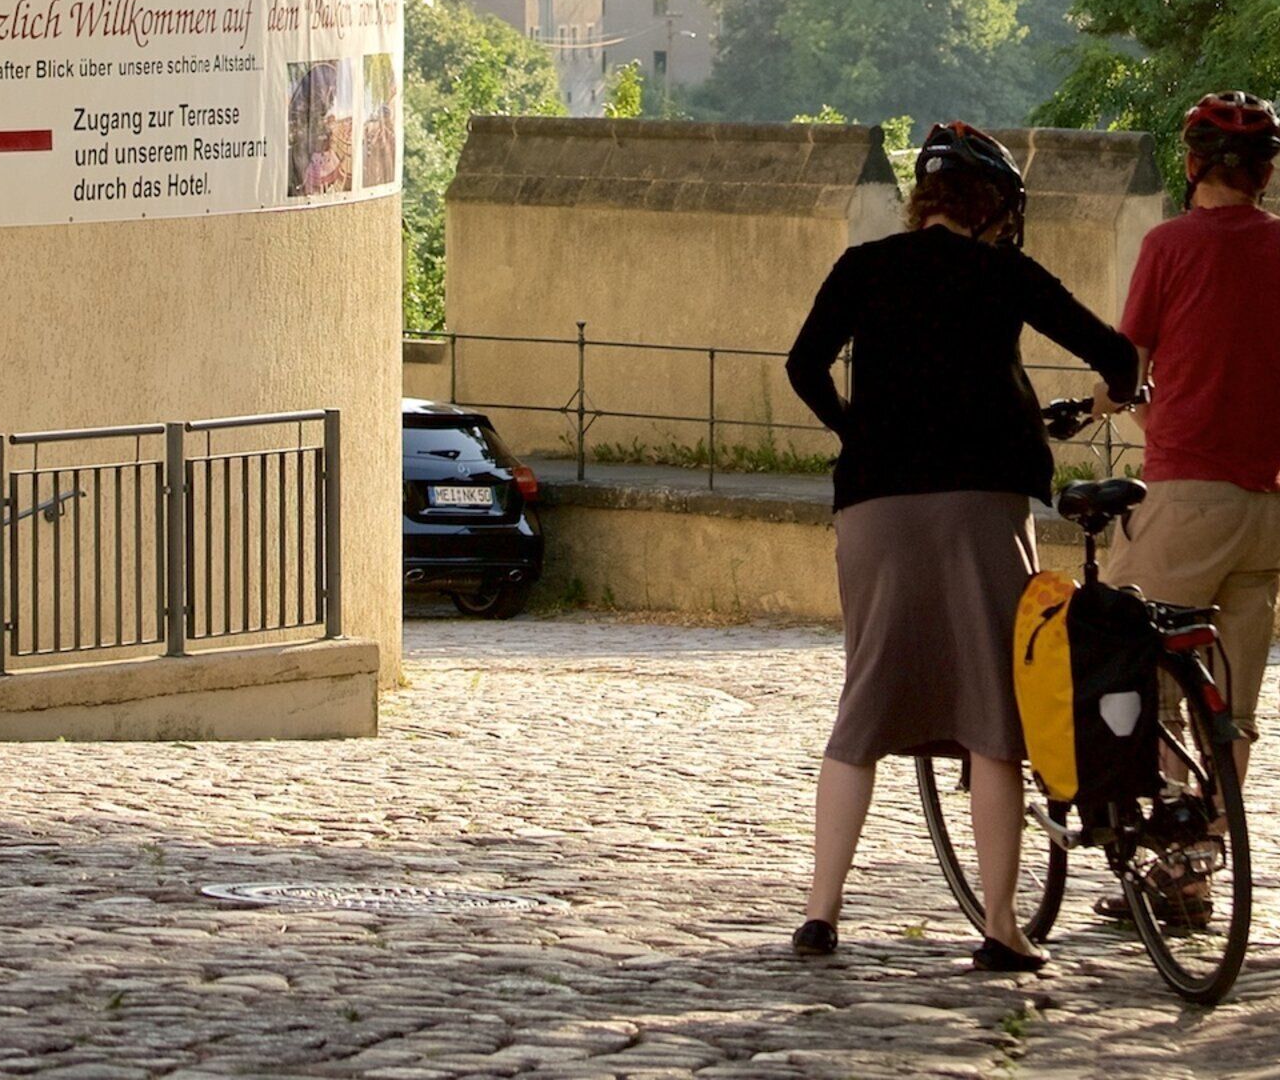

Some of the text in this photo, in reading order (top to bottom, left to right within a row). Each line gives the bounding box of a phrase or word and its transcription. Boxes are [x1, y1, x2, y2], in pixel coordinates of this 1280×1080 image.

[36, 59, 74, 79] Blick
[79, 58, 112, 77] über
[119, 59, 163, 76] unsere
[167, 55, 210, 74] schöne
[73, 104, 240, 136] Zugang zur Terrasse
[75, 136, 268, 166] und unserem Restaurant
[73, 172, 211, 201] durch das Hotel.
